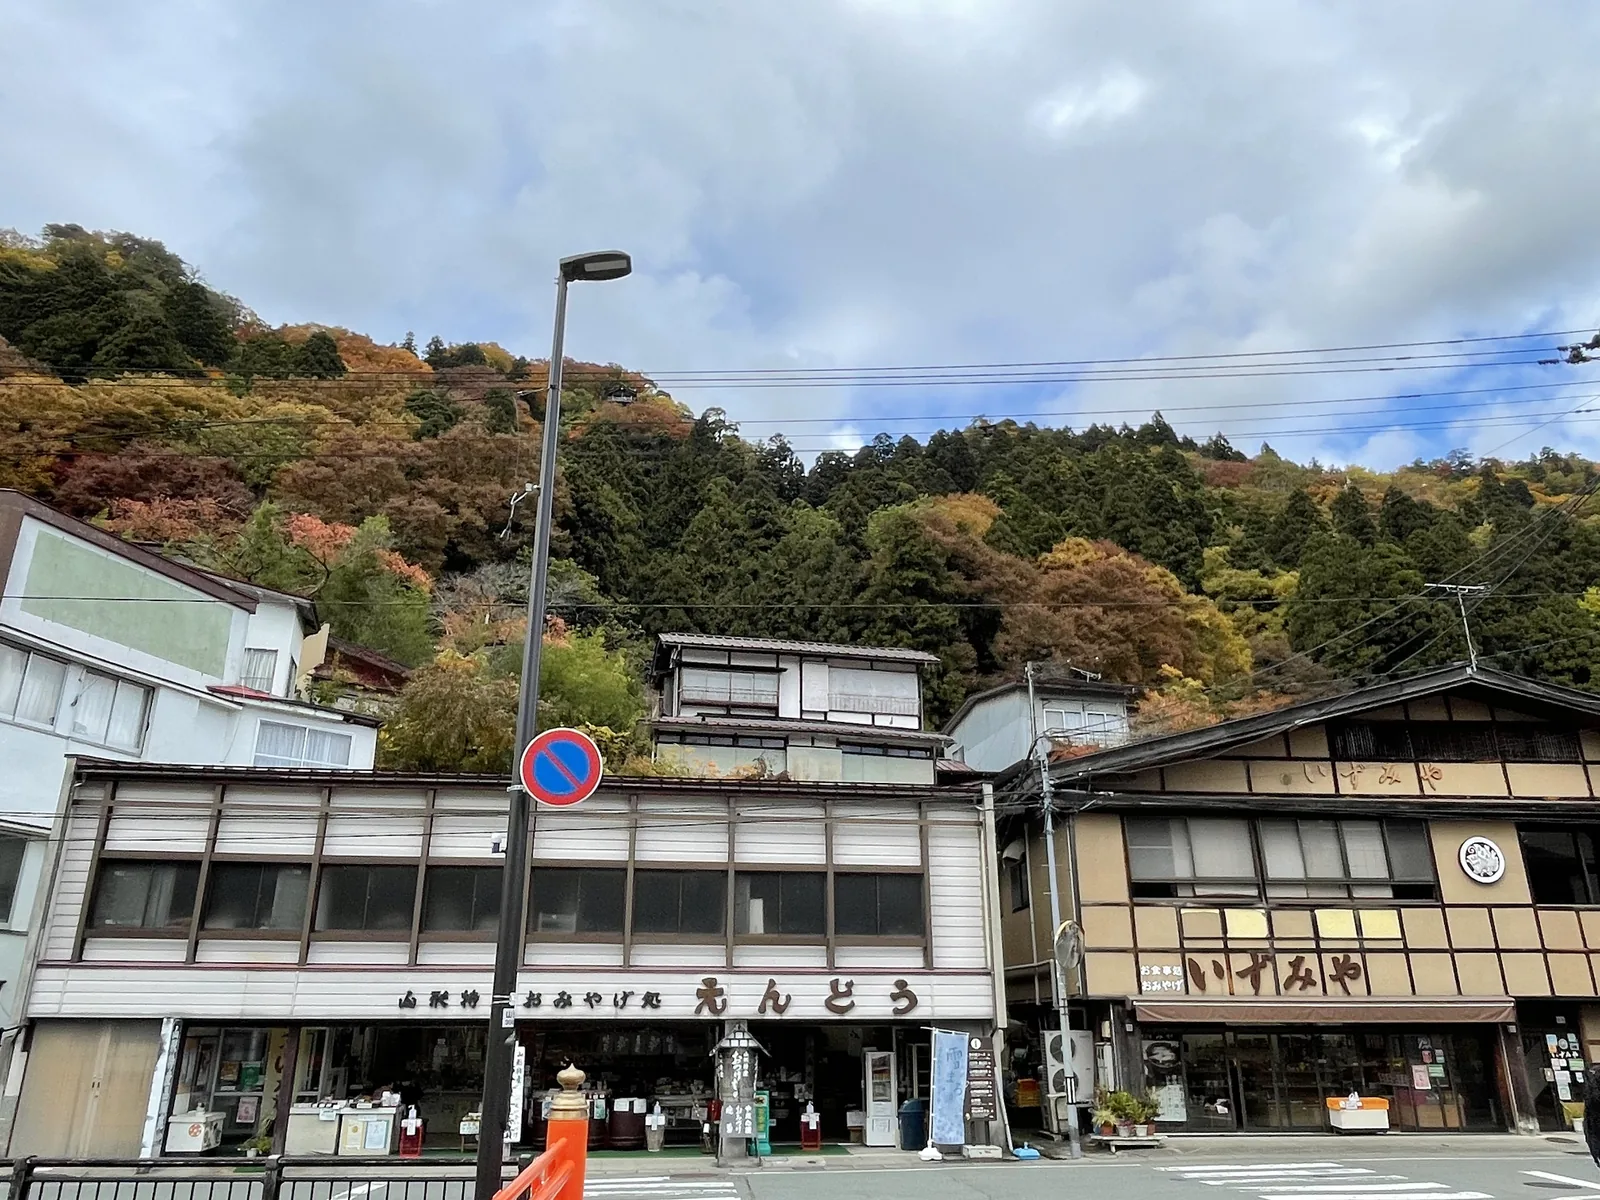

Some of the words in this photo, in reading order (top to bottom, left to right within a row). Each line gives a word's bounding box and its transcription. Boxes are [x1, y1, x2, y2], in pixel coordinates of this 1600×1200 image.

[1140, 965, 1182, 976] お食事処
[1141, 979, 1184, 991] おみやげ
[398, 989, 480, 1009] 山形特
[523, 990, 662, 1009] おみやげ処
[694, 977, 918, 1014] えんどう
